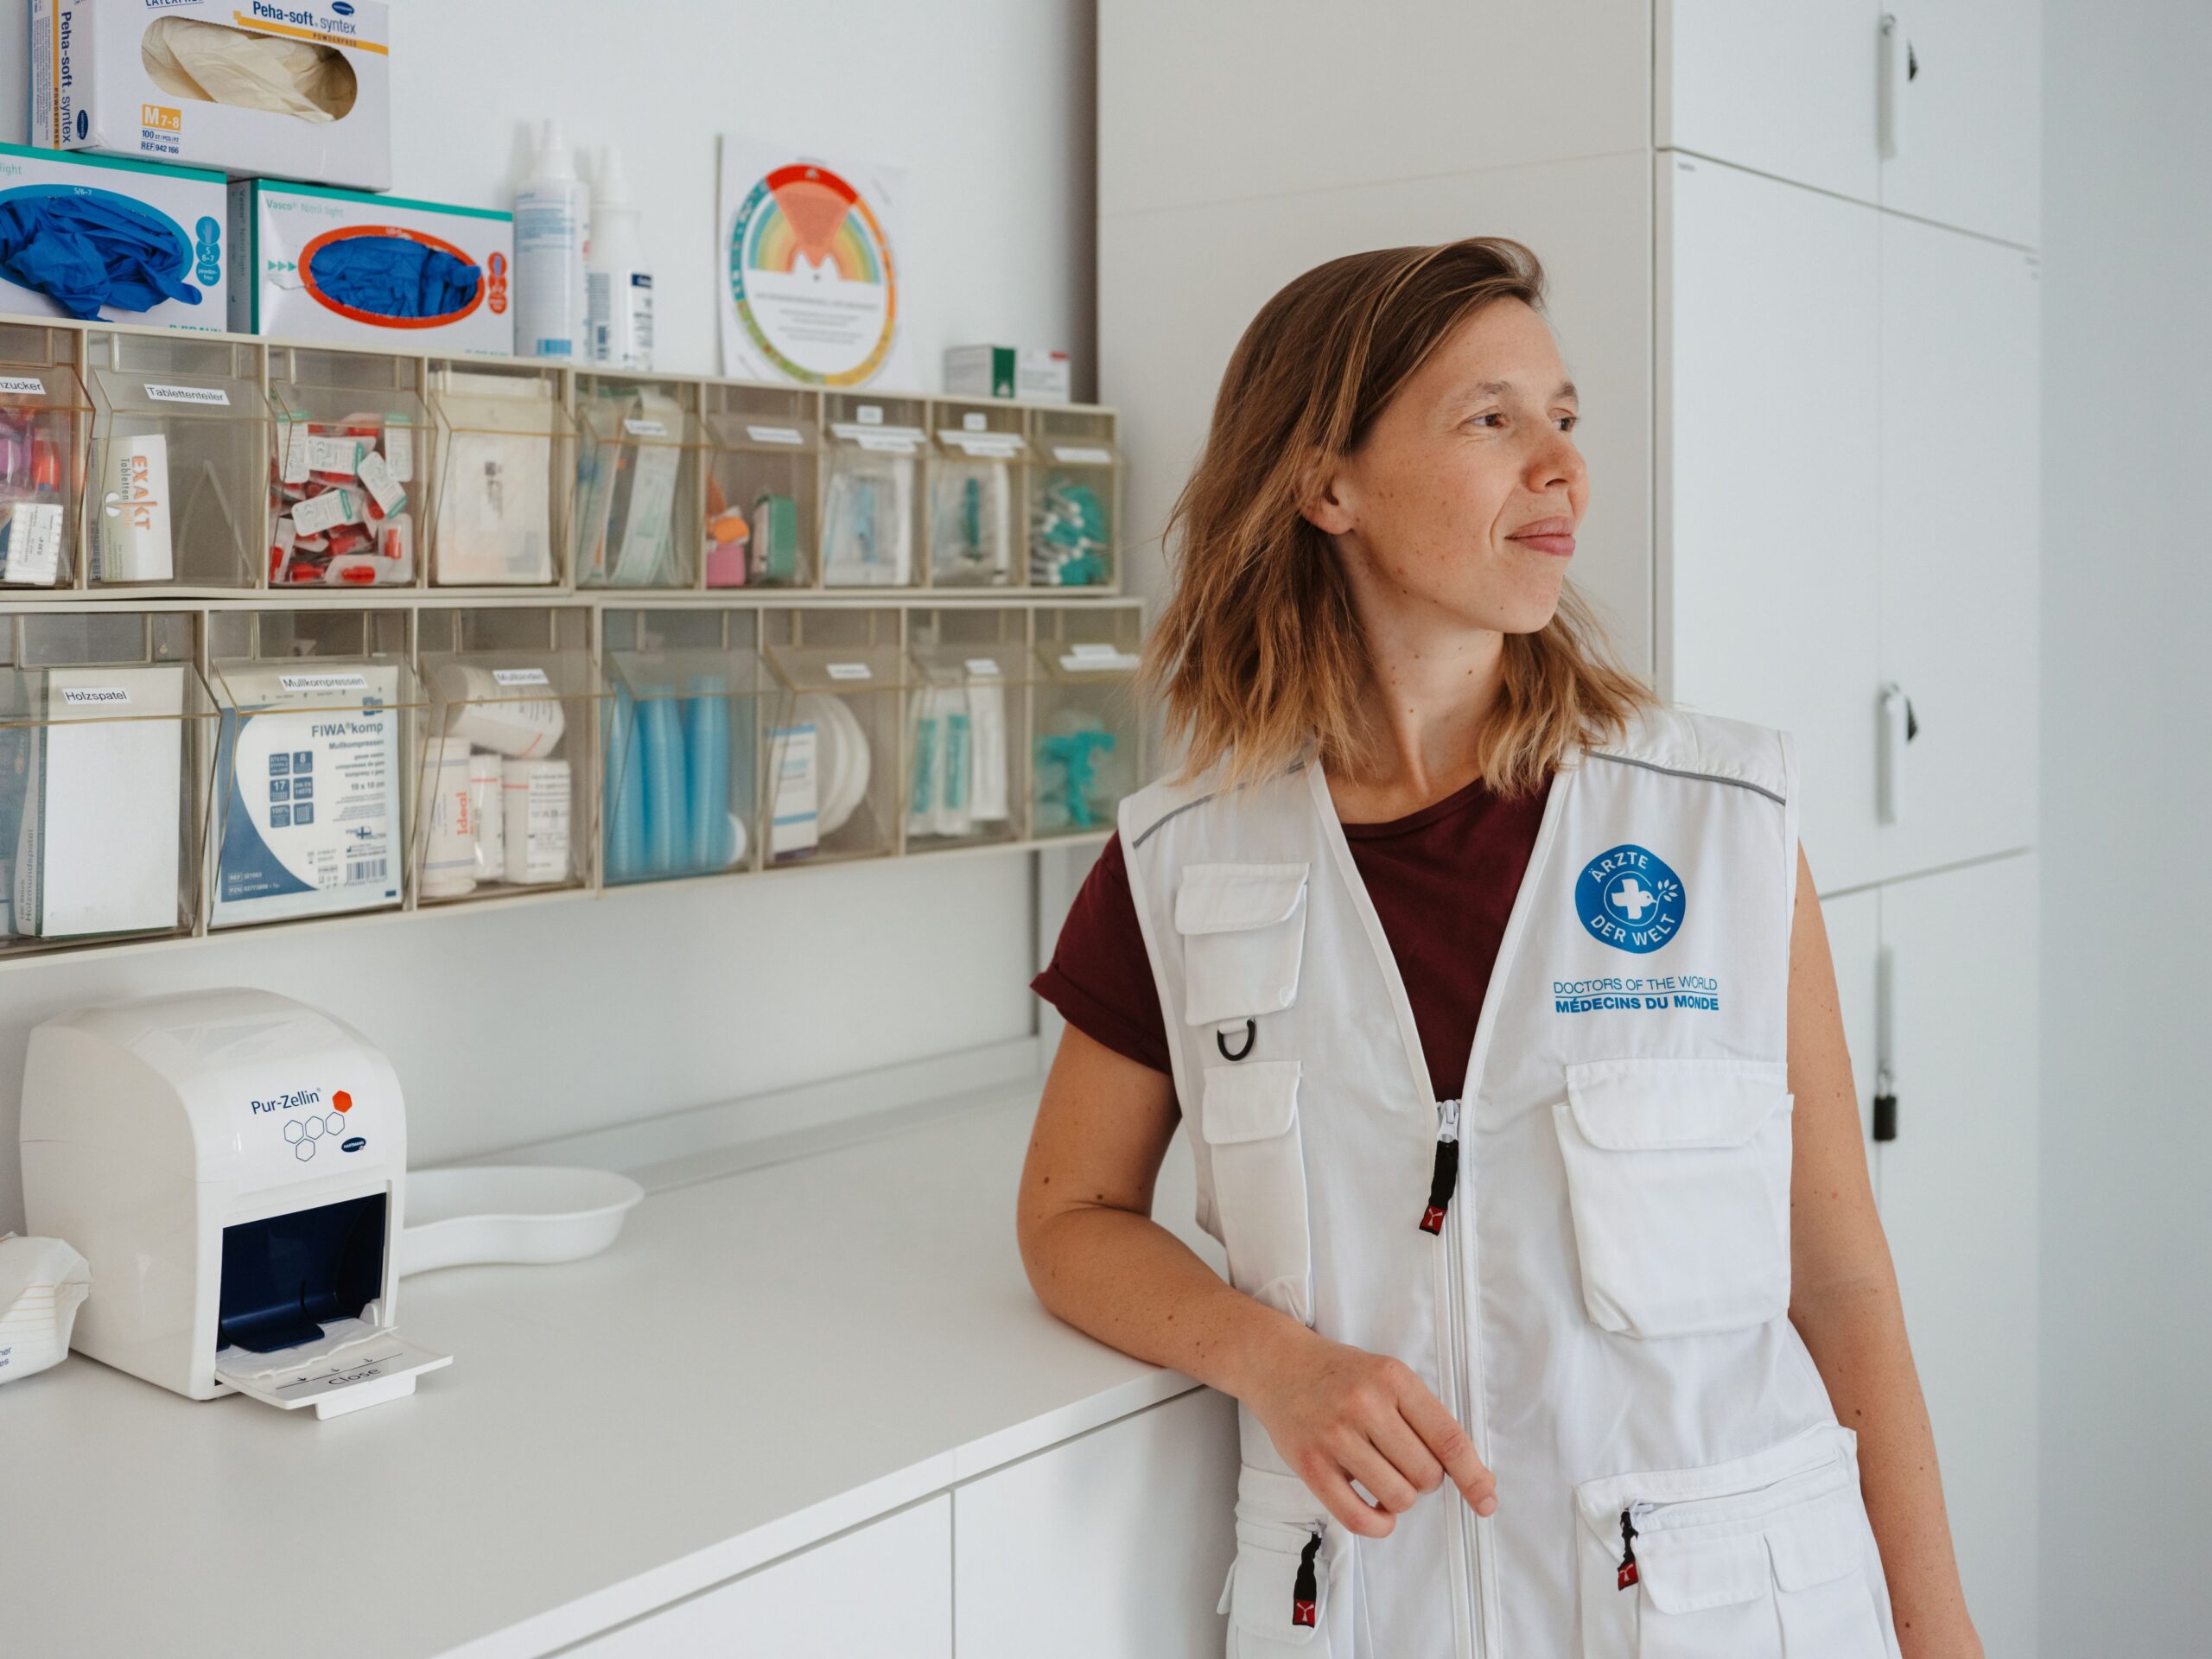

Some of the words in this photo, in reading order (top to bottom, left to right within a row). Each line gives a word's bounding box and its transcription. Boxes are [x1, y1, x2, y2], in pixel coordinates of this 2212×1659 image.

[320, 17, 357, 35] syntex
[313, 33, 357, 47] POWDERFREE
[60, 96, 71, 143] syntex
[144, 105, 160, 125] M
[161, 114, 180, 128] 7-8
[142, 130, 155, 139] 100
[141, 142, 154, 150] REF
[155, 143, 168, 152] 942
[206, 246, 211, 255] S
[147, 386, 224, 401] Tablettenteiler
[120, 457, 131, 501] Tabletten
[131, 455, 158, 531] EXAKT
[283, 677, 365, 688] Mullkompressen
[65, 690, 127, 702] Holzspatel
[299, 753, 306, 763] 8
[274, 780, 286, 791] 17
[456, 791, 468, 836] Ideal
[25, 829, 35, 922] Holzmundspatel
[1588, 851, 1649, 883] ÄRZTE
[1590, 914, 1627, 944] DER
[1631, 912, 1675, 946] WELT
[1554, 977, 1623, 994] DOCTORS
[1625, 978, 1643, 991] OF
[1646, 976, 1676, 991] THE
[1678, 976, 1718, 991] WORLD
[1555, 996, 1642, 1014] MÉDECINS
[1645, 996, 1669, 1010] DU
[1674, 995, 1719, 1011] MONDE
[328, 1369, 381, 1385] Close
